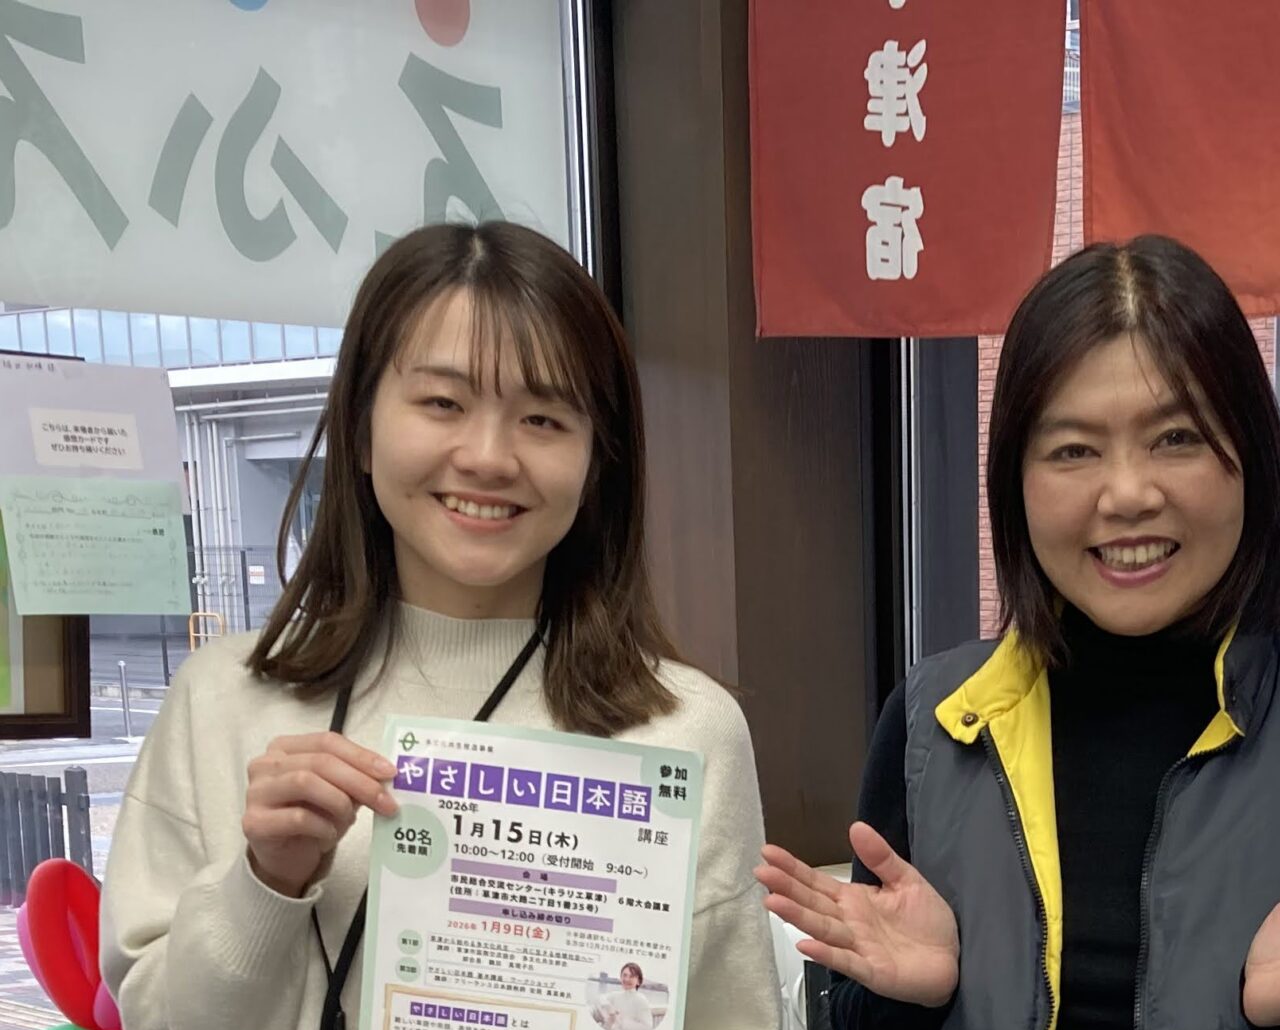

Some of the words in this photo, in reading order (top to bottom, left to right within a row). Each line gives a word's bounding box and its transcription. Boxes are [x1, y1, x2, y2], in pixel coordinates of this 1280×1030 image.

[659, 764, 688, 780] 参加
[398, 759, 648, 817] やさしい日本語
[658, 783, 687, 800] 無料
[438, 799, 478, 813] 2026年
[394, 826, 432, 845] 60名
[452, 814, 579, 850] 1月15日(木)
[637, 827, 669, 846] 講座
[481, 919, 550, 940] 1月9日(金)
[511, 1018, 529, 1028] とは
